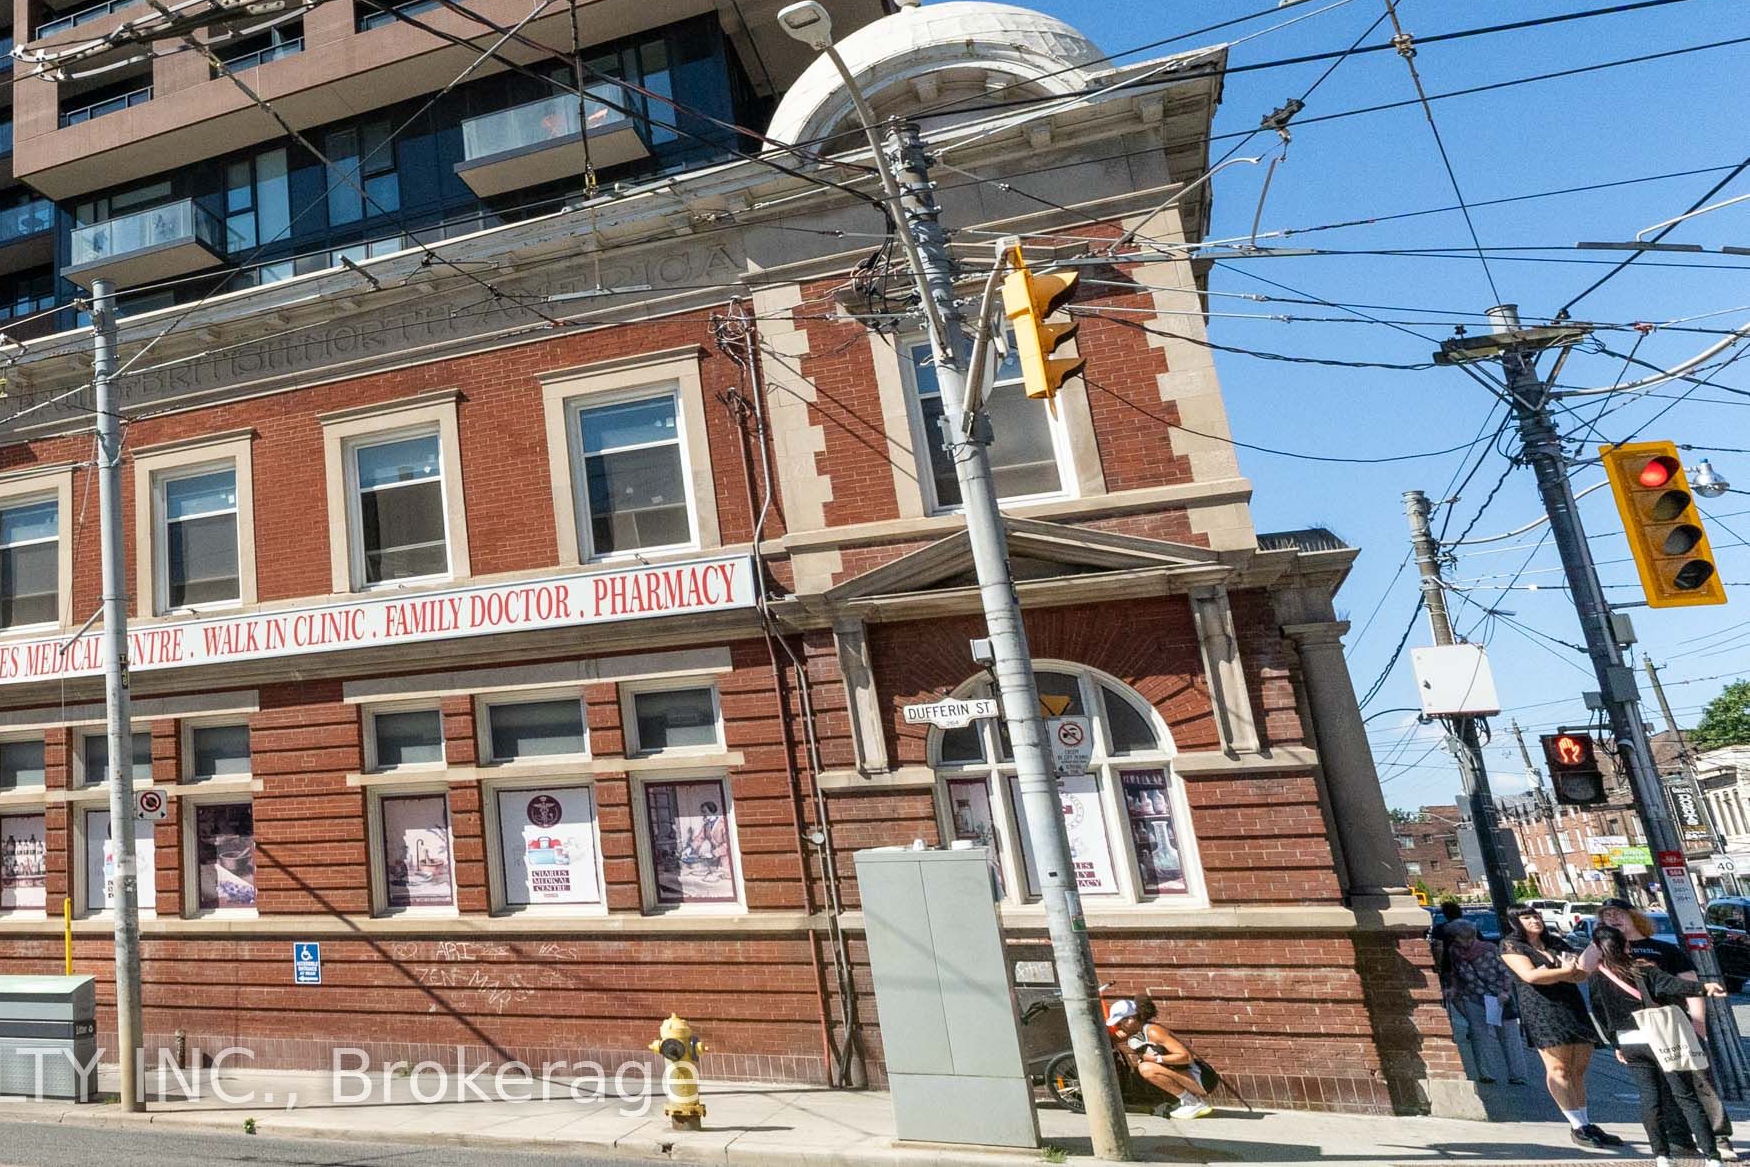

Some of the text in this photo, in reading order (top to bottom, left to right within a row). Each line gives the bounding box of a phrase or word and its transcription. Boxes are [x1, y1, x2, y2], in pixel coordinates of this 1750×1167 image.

[140, 340, 298, 394] BRITISH
[303, 304, 456, 361] NORTH
[24, 636, 104, 677] MEDICAL
[128, 629, 184, 665] NTRE
[203, 621, 259, 657] WALK
[264, 618, 287, 651] IN
[293, 608, 365, 647] CLINIC
[385, 596, 462, 637] FAMILY
[469, 584, 571, 628] DOCTOR
[593, 563, 736, 617] PHARMACY
[908, 701, 991, 720] DUFFERIN ST
[1717, 861, 1735, 872] 40
